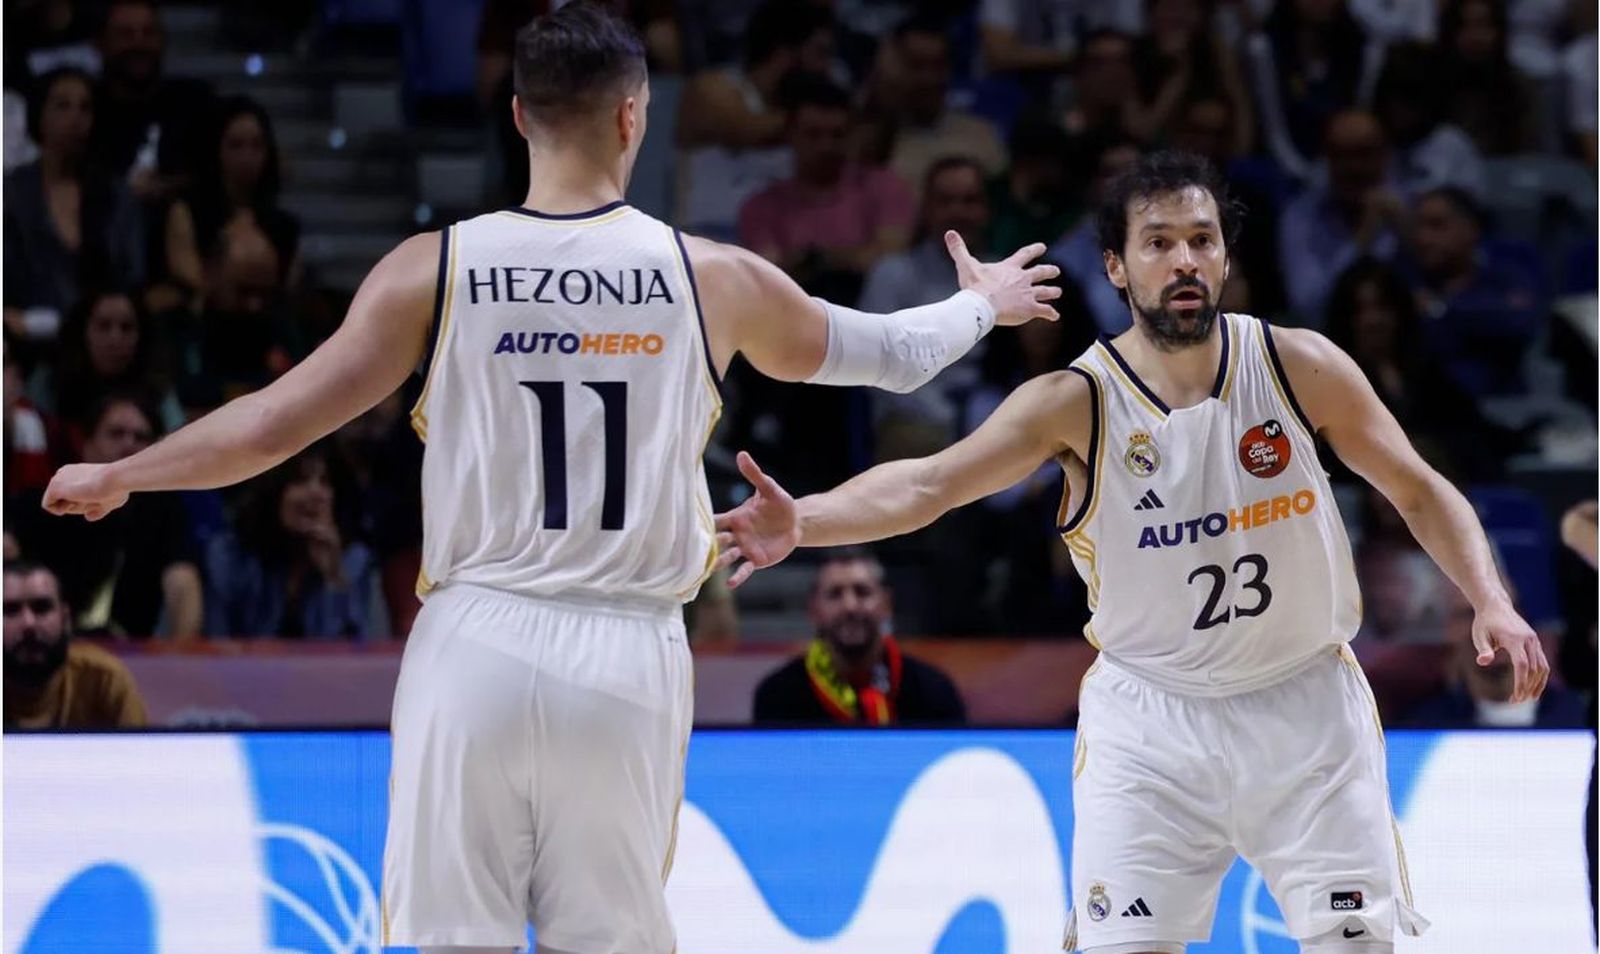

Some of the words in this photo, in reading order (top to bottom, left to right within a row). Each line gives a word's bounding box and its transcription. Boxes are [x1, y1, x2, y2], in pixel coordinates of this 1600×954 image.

[468, 266, 674, 305] HEZONJA
[494, 332, 664, 355] AUTOHERO
[519, 381, 628, 531] 11
[1248, 445, 1274, 458] Copa
[1137, 489, 1316, 549] AUTOHERO
[1187, 553, 1273, 630] 23
[1333, 898, 1356, 909] acb
